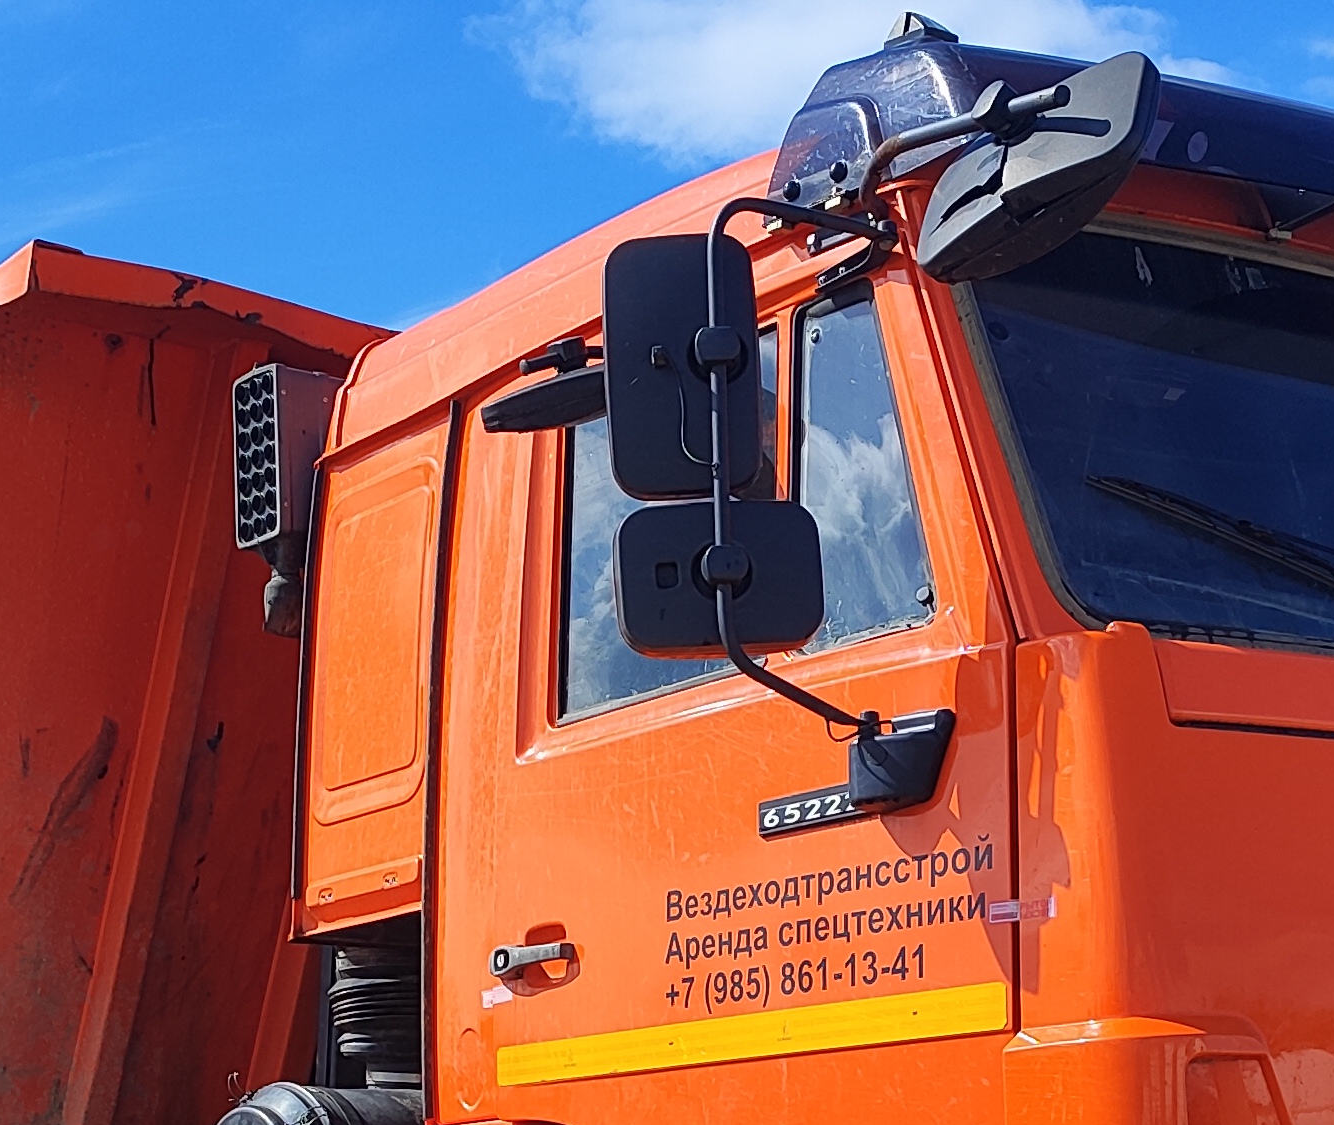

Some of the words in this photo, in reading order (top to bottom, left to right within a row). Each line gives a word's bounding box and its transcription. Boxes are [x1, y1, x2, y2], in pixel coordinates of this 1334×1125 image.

[667, 834, 993, 922] Вездеходтрансстрой
[666, 924, 768, 968] Аренда
[779, 891, 987, 947] спецтехники
[666, 975, 695, 1009] +7
[704, 964, 770, 1014] (985)
[781, 943, 925, 996] 861-13-41
